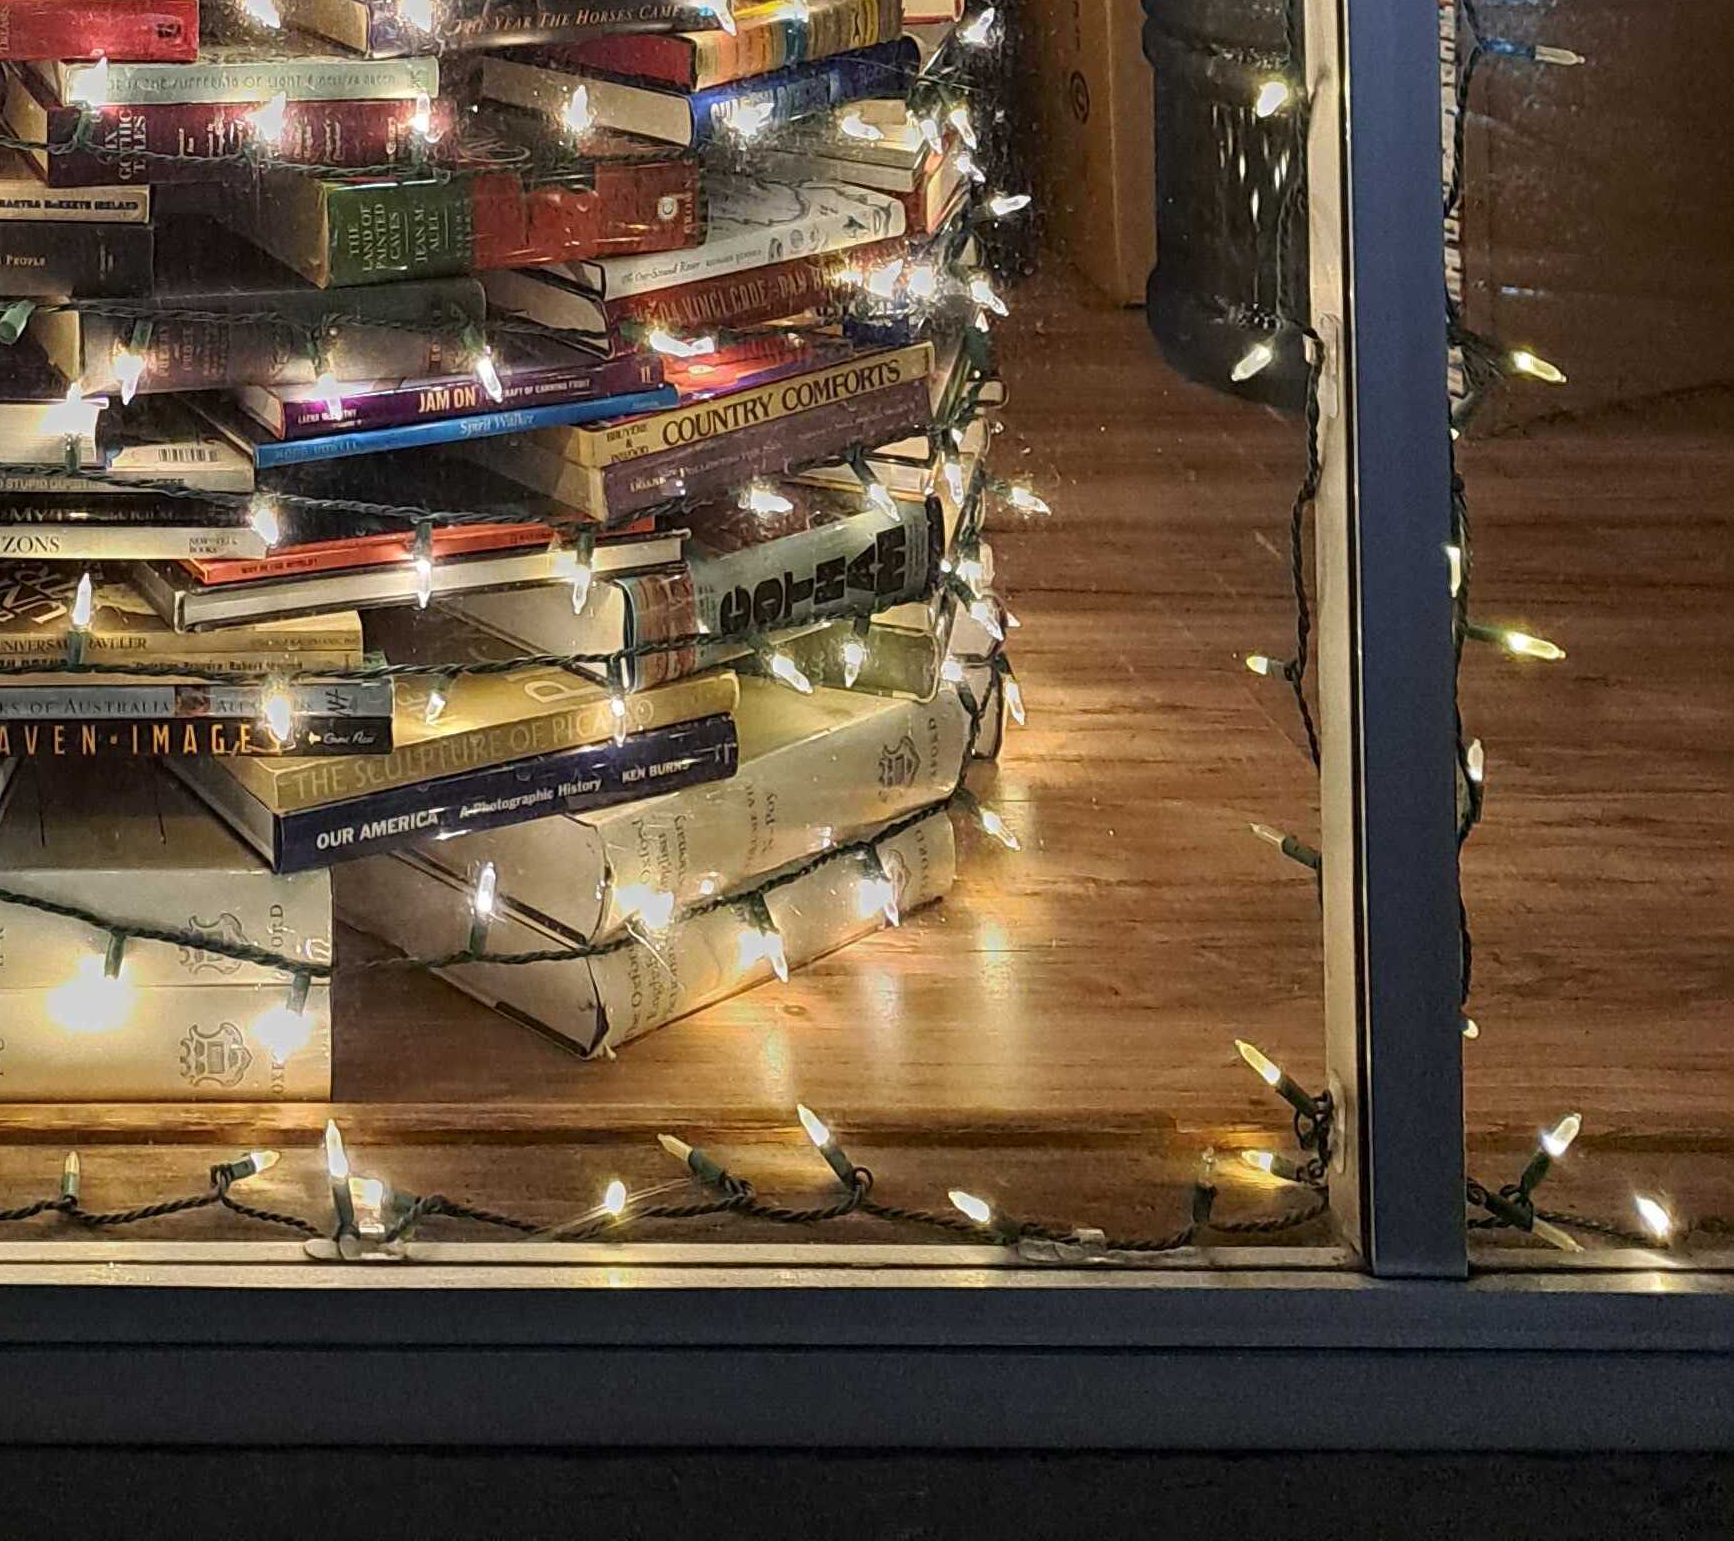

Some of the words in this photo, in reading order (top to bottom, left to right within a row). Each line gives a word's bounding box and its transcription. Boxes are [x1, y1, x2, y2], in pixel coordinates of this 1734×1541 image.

[576, 5, 636, 25] HORSES
[390, 211, 402, 260] CAVES
[418, 387, 451, 413] JAM
[453, 385, 477, 409] ON
[662, 395, 773, 446] COUNTRY
[782, 358, 902, 412] COMFORTS
[66, 697, 171, 716] AUSTRALIA
[294, 761, 353, 802] THE
[354, 727, 502, 788] SCULPTURE
[507, 716, 547, 752] OF
[471, 787, 554, 815] Photographic
[556, 777, 603, 801] History
[621, 766, 648, 784] KEN
[315, 828, 356, 851] OUR
[358, 808, 440, 844] AMERICA
